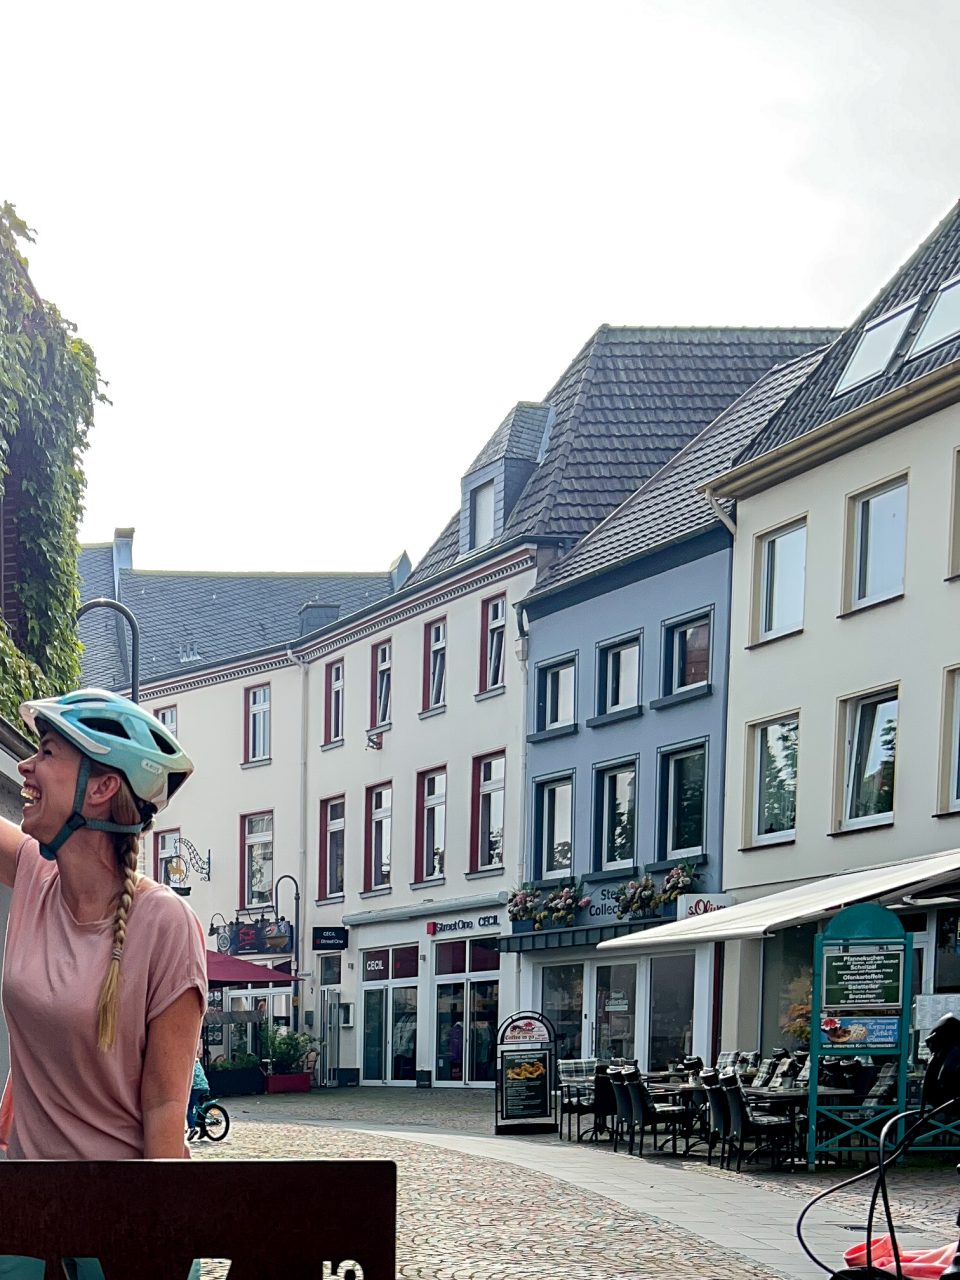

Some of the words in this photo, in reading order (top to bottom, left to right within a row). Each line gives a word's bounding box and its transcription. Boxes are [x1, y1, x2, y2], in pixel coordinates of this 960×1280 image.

[436, 921, 458, 933] Street
[457, 920, 474, 930] One
[478, 915, 501, 927] CECIL
[366, 960, 384, 970] CECIL
